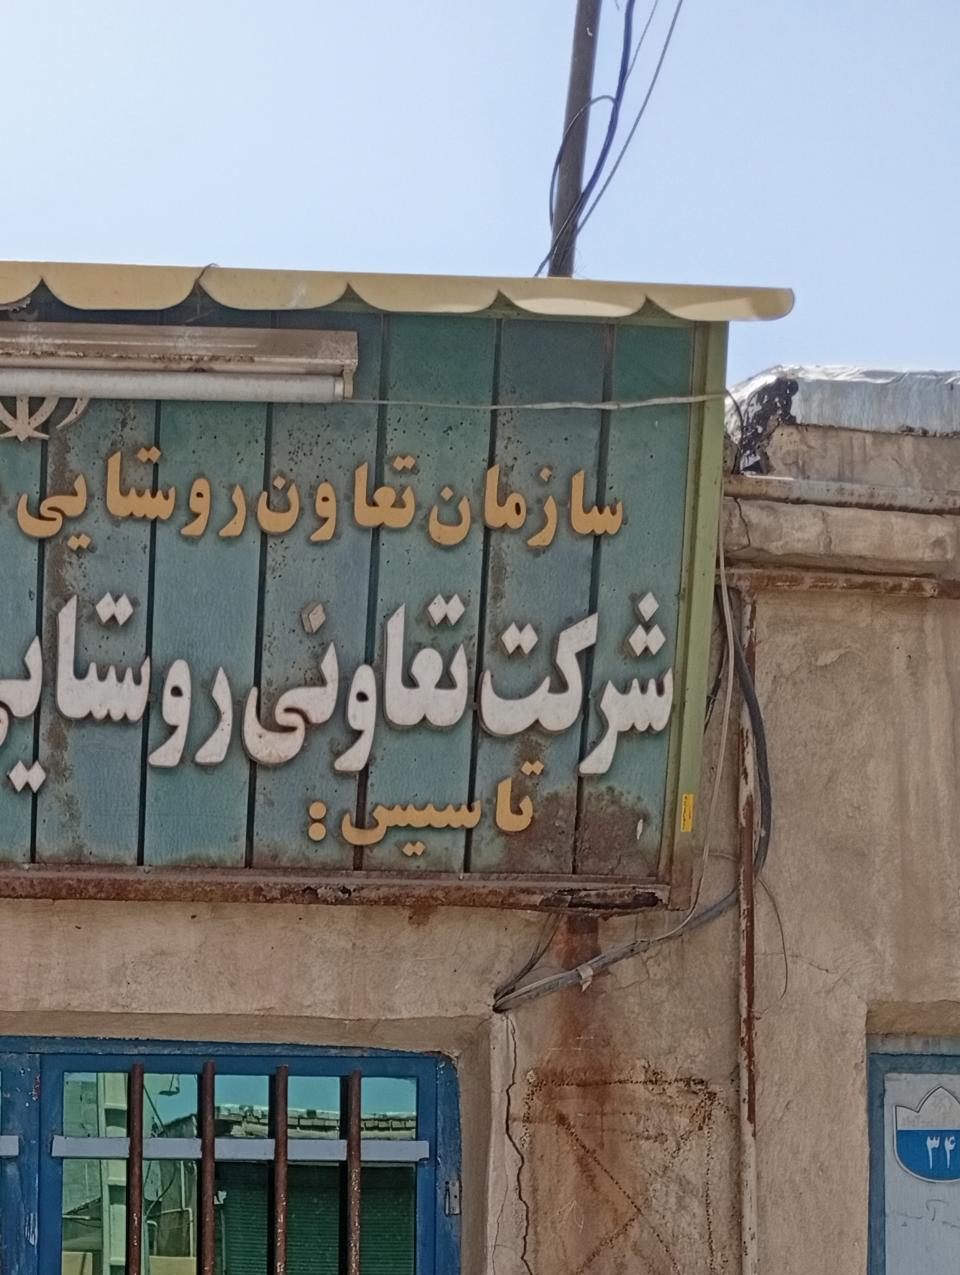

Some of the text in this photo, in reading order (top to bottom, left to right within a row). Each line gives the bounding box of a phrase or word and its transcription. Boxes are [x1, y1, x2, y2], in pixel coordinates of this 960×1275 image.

[15, 446, 246, 550] روستایی
[256, 456, 416, 543] تعاون
[428, 464, 624, 548] سازمان
[242, 593, 470, 774] تعاونی
[478, 592, 675, 776] شرکت
[926, 1135, 956, 1169] ۳۴
